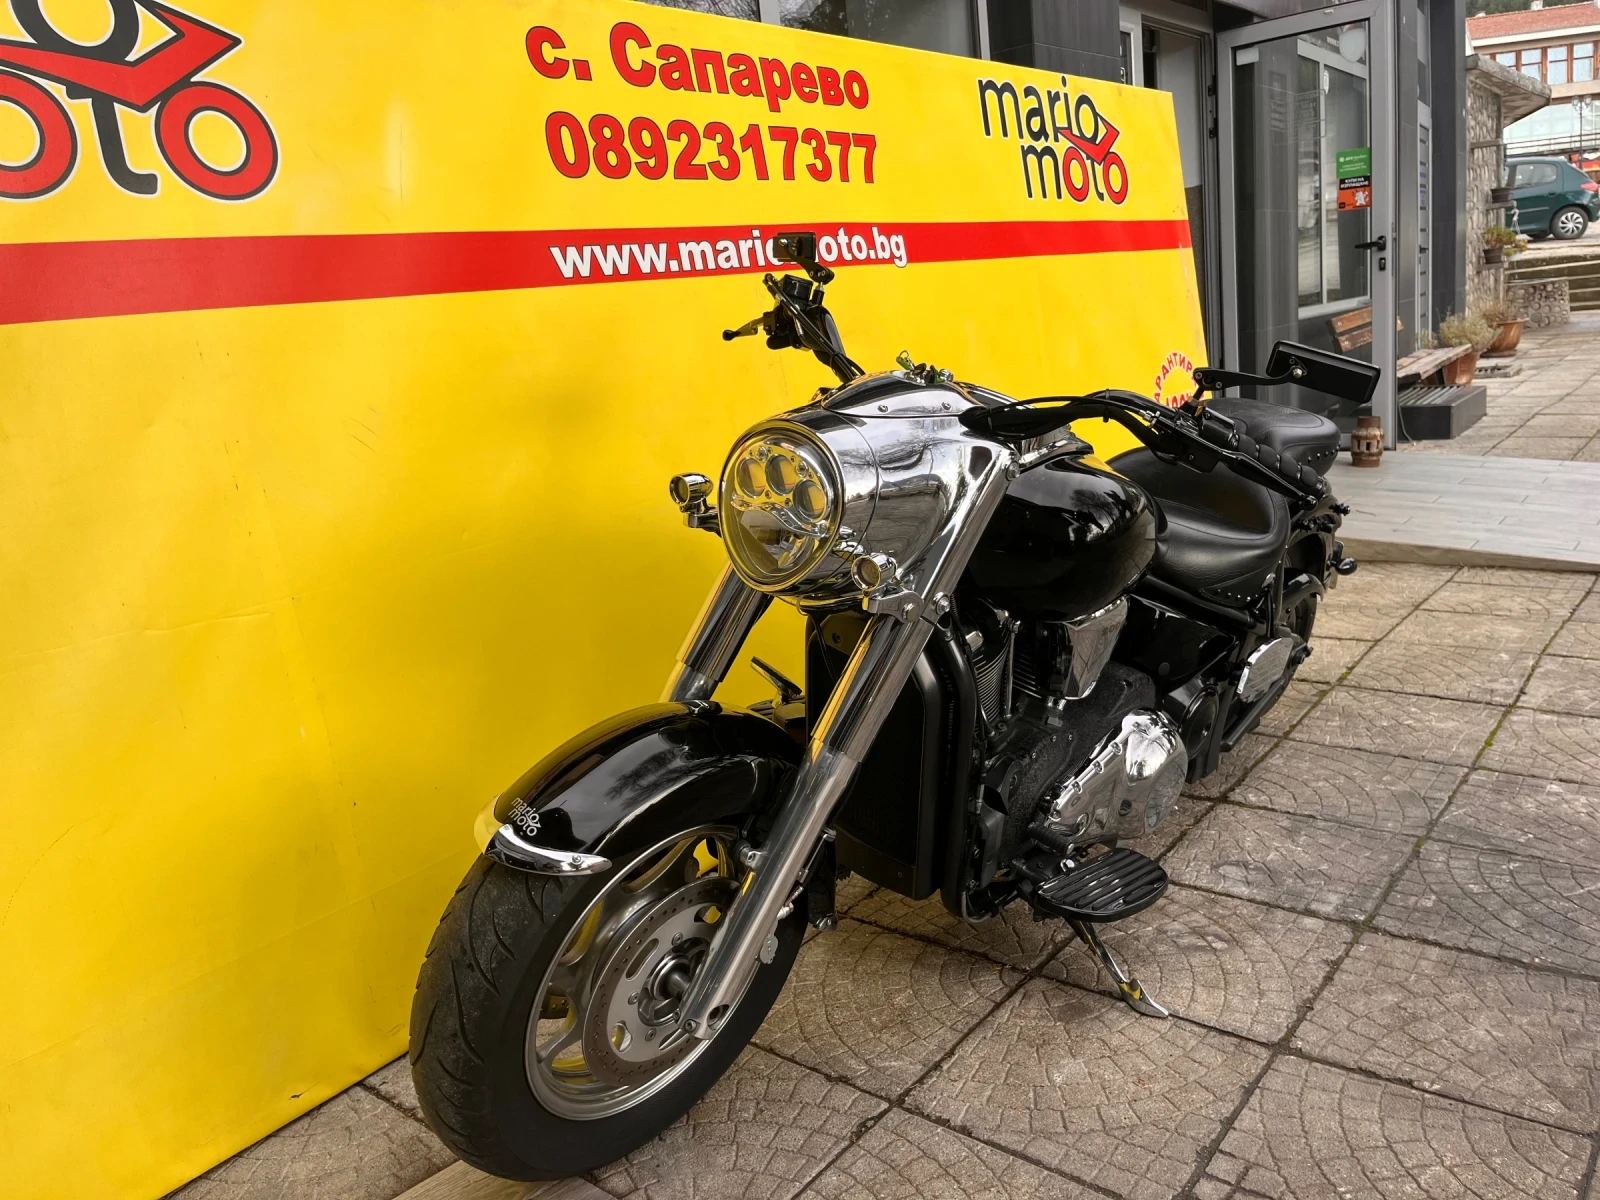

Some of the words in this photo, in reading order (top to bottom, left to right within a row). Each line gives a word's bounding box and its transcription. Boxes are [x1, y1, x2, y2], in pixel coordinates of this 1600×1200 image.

[525, 26, 593, 81] с.
[609, 21, 869, 113] Сапарево
[977, 75, 1101, 146] mario
[545, 110, 877, 184] 0892317377
[1021, 144, 1129, 205] moto
